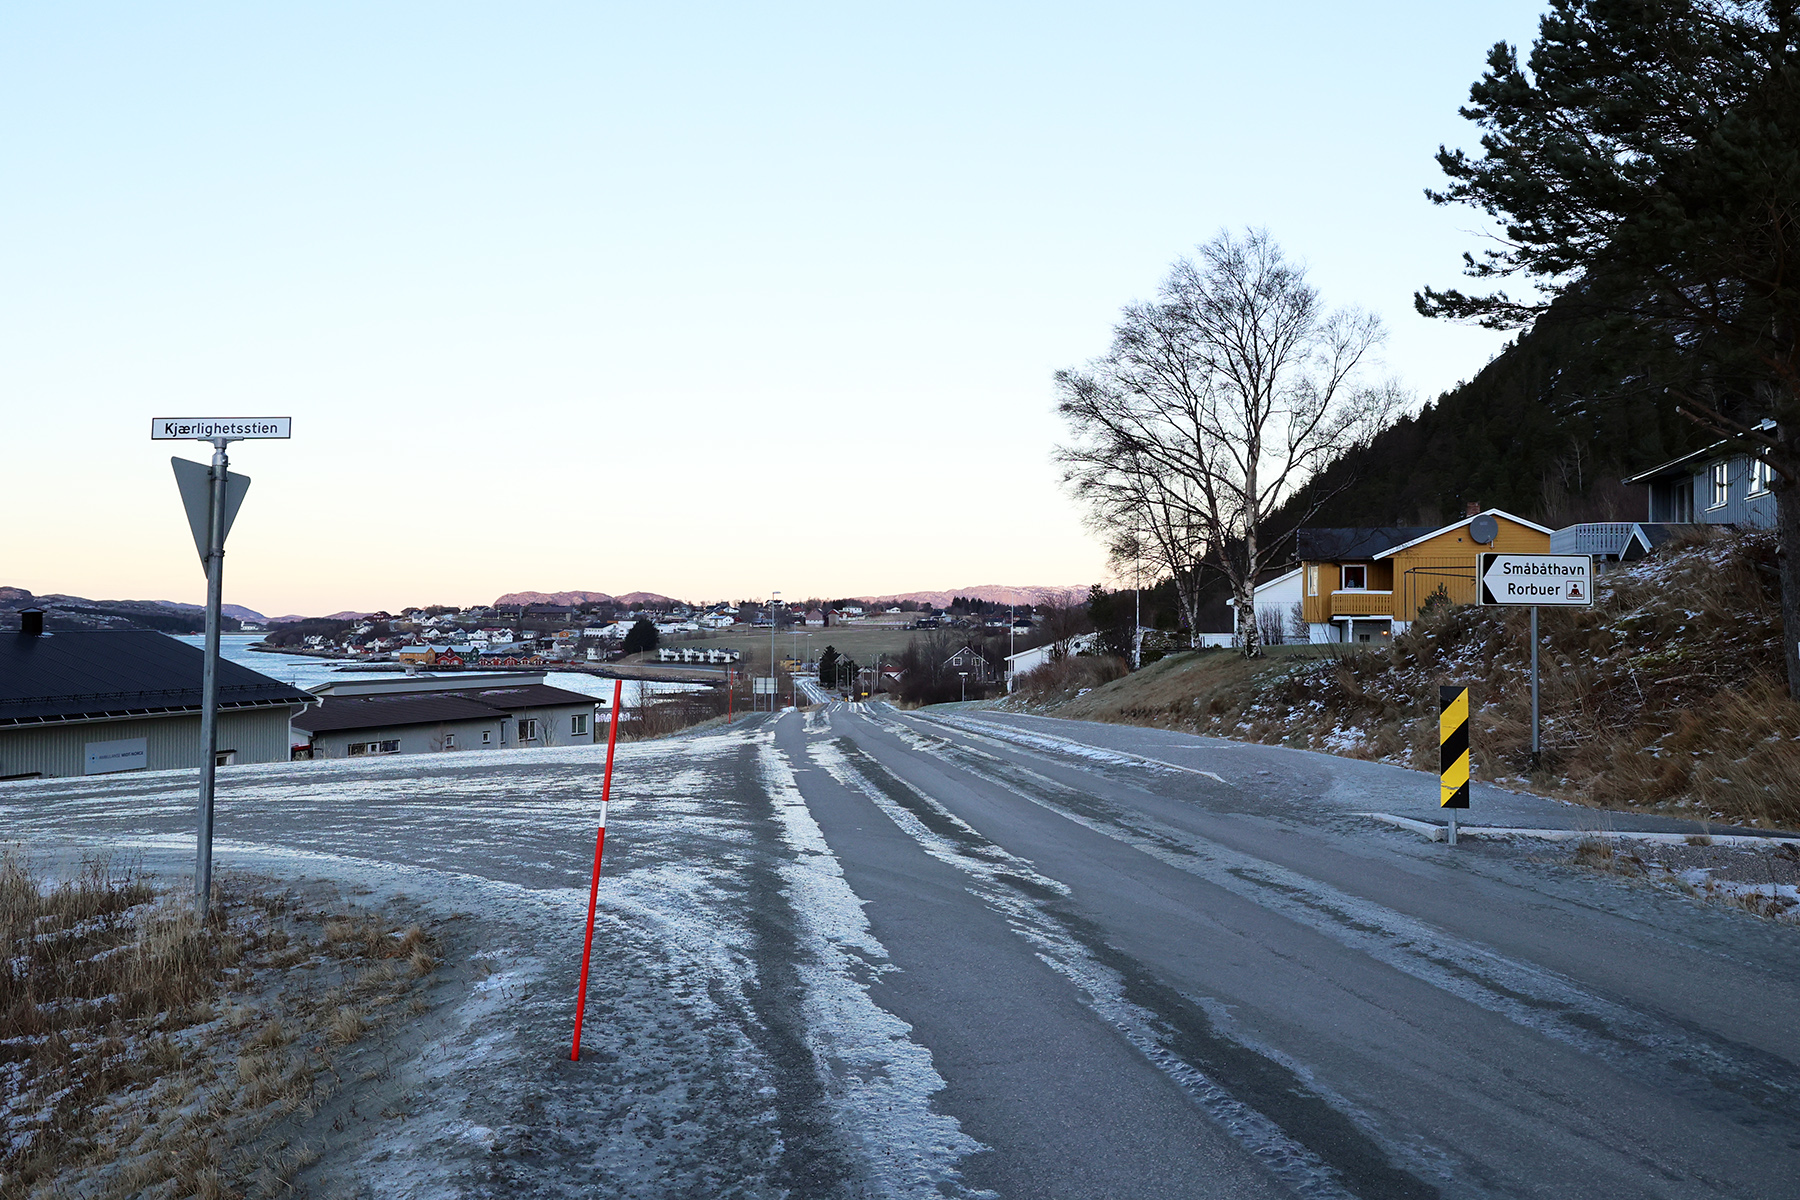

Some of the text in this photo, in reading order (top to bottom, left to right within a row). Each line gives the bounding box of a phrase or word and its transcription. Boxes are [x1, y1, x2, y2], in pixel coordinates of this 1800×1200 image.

[164, 422, 278, 437] Kjærlighetsstien
[1503, 562, 1585, 576] Småbåthavn
[1508, 582, 1561, 595] Rorbuer
